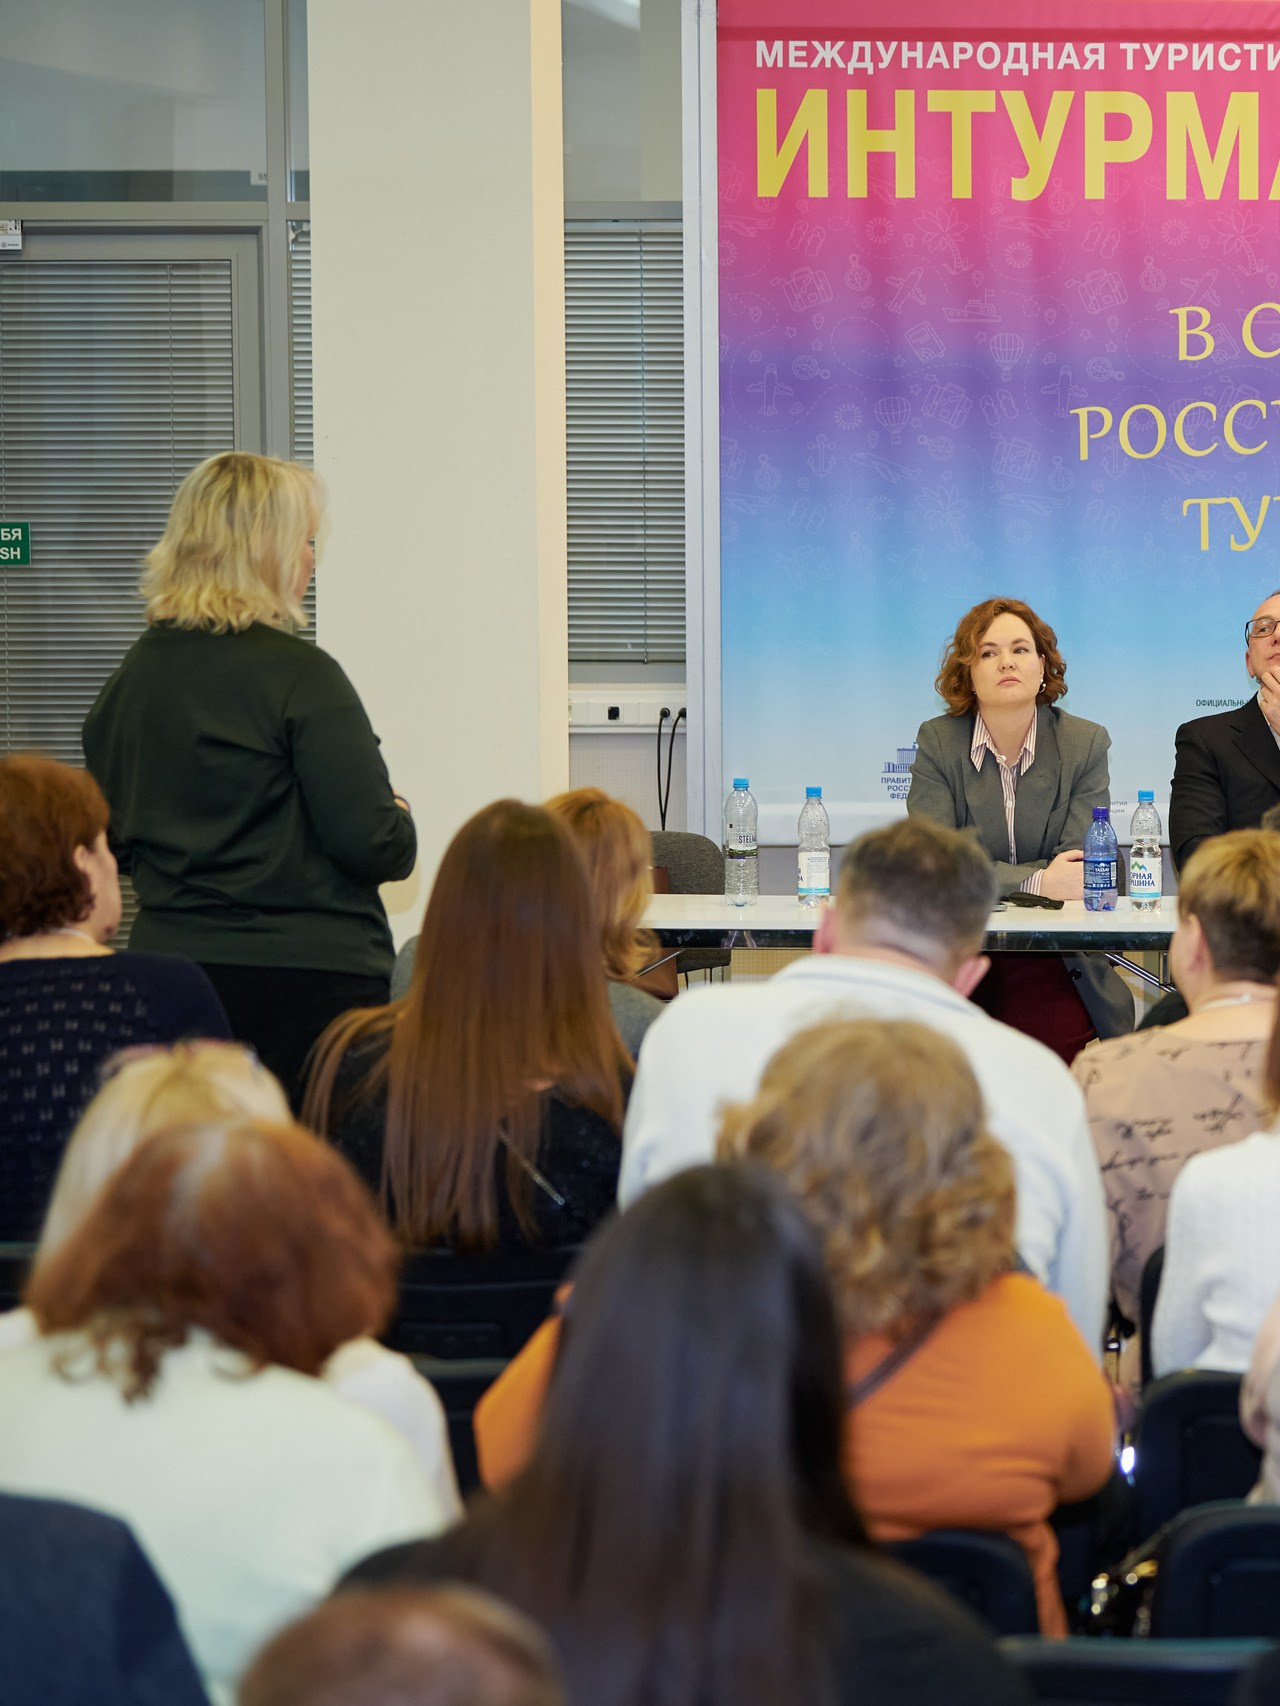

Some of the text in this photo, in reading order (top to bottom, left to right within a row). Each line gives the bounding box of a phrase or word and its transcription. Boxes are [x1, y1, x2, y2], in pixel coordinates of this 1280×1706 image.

[756, 40, 1105, 75] МЕЖДУНАРОДНАЯ
[1170, 305, 1216, 361] В
[0, 527, 22, 541] БЯ
[0, 546, 21, 560] SH
